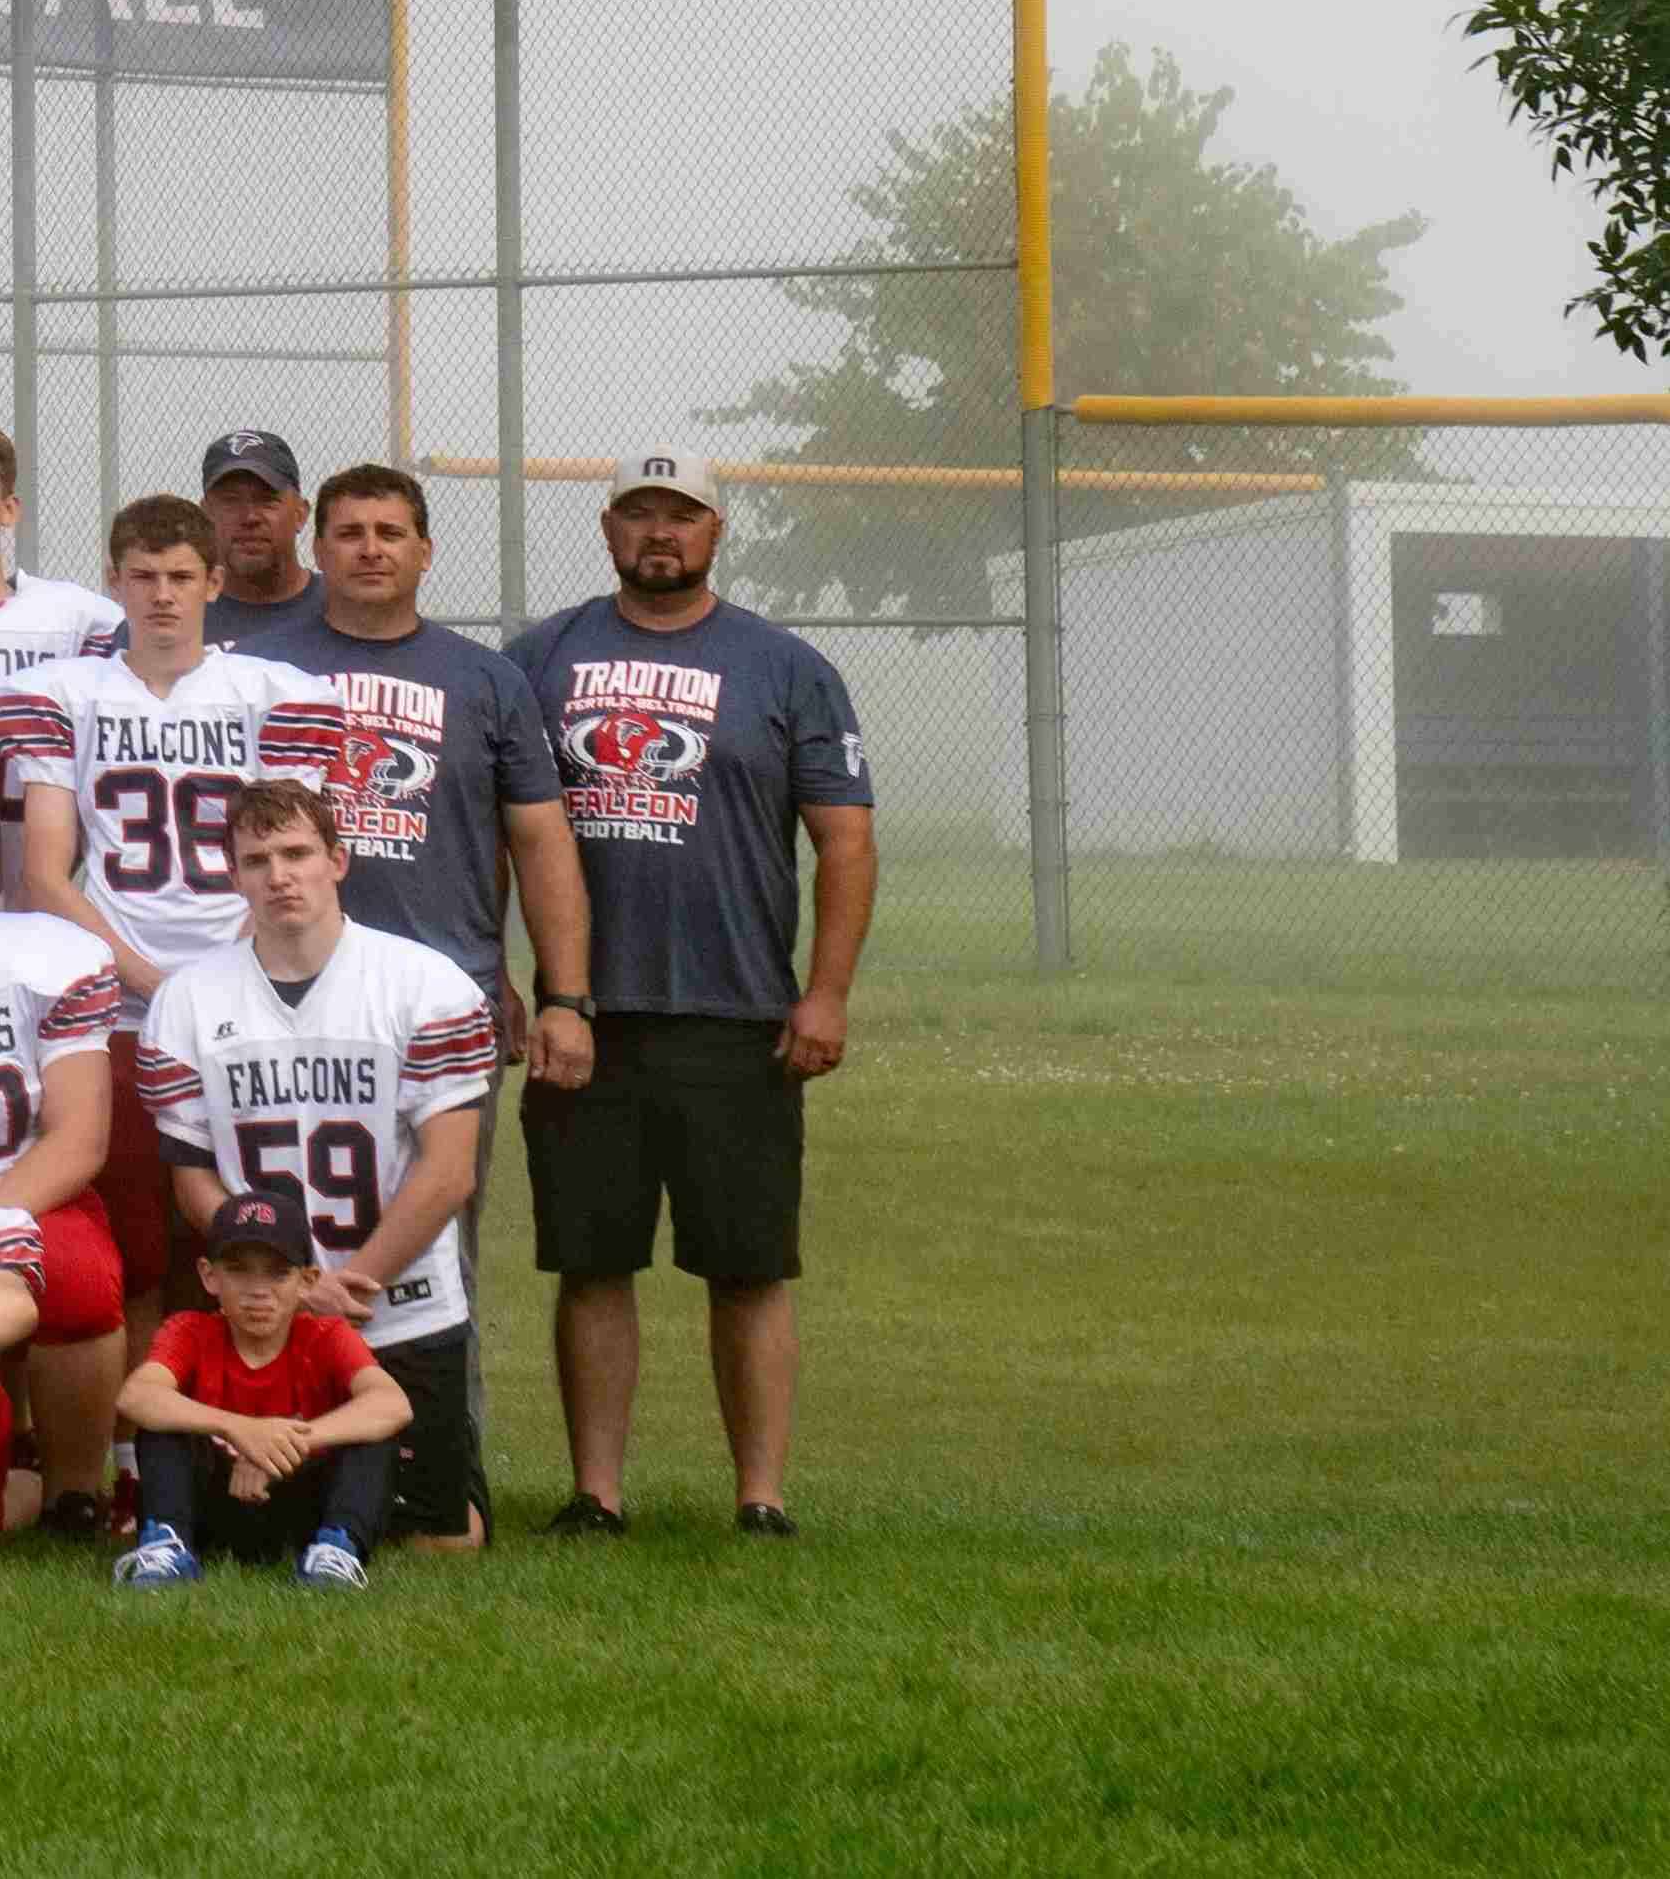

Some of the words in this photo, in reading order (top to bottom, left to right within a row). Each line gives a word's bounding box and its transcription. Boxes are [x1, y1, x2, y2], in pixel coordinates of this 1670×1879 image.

[324, 672, 447, 729] ADITION
[572, 660, 722, 709] TRADITION
[95, 715, 247, 769] FALCONS
[333, 806, 428, 843] LCON
[563, 787, 699, 827] FALCON
[340, 837, 416, 862] TBALL
[573, 819, 685, 846] FOOTBALL
[226, 1056, 377, 1110] FALCONS
[233, 1118, 384, 1252] 59
